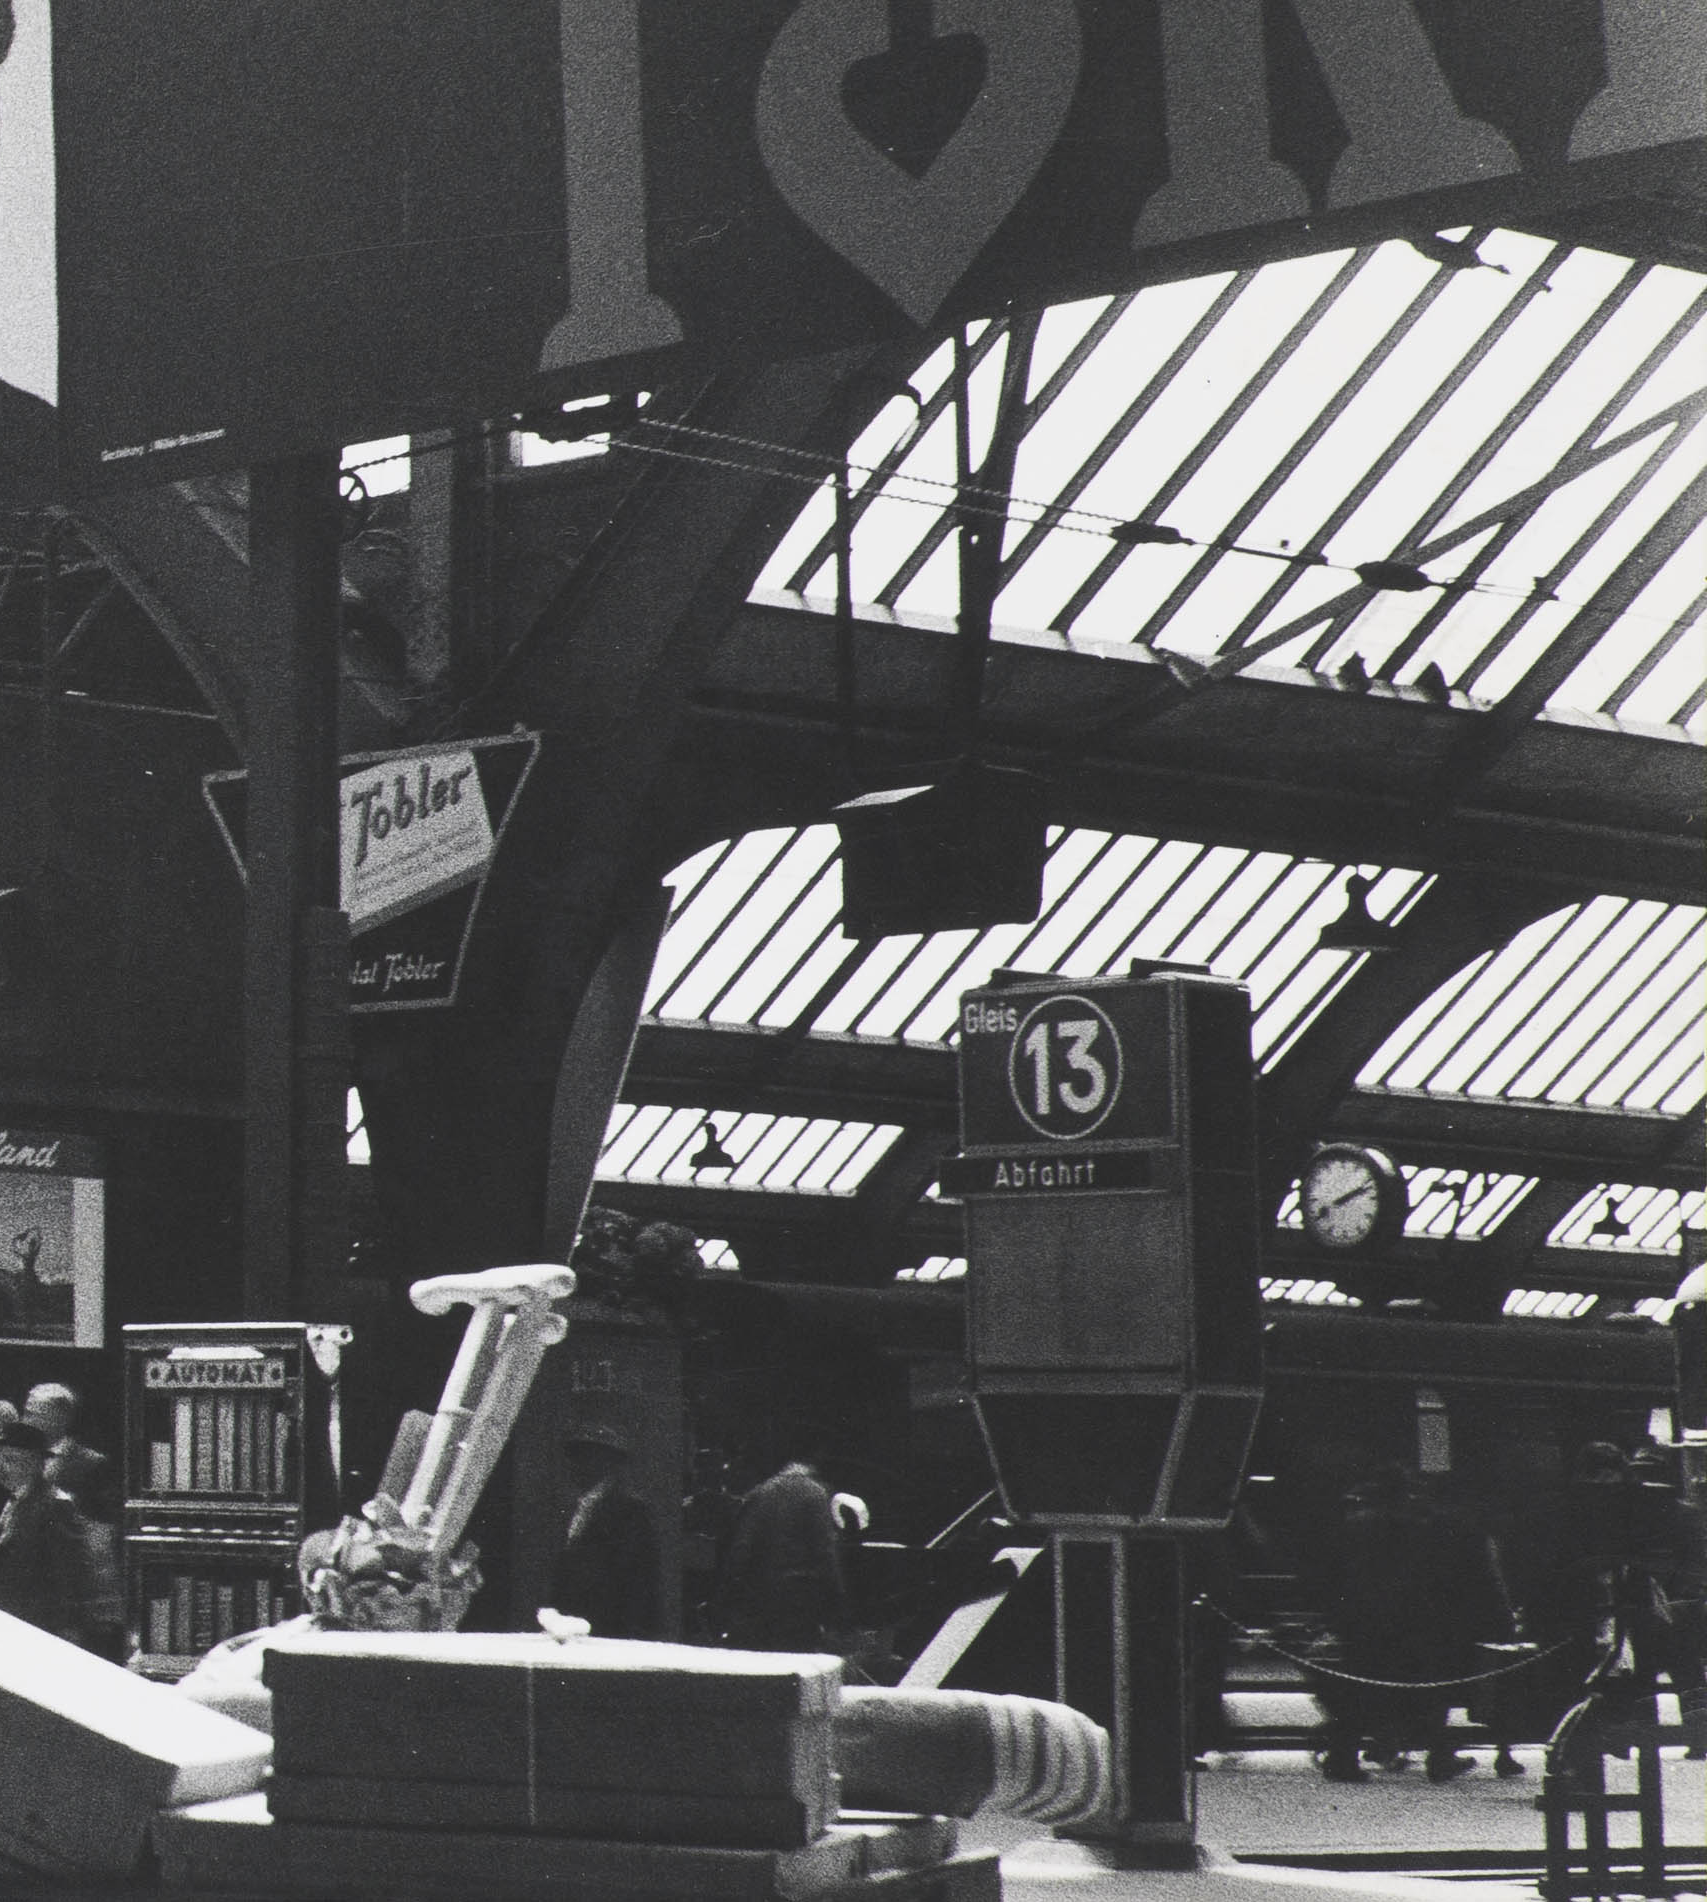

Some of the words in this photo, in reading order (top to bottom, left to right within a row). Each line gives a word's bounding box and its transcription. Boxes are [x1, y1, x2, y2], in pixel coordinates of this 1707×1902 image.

[350, 762, 473, 868] Tobler
[383, 952, 446, 993] Tobler
[964, 1001, 1019, 1035] Gleis
[1023, 1019, 1108, 1116] 13
[994, 1158, 1096, 1190] Abfahrt
[165, 1362, 266, 1384] AUTOMAT
